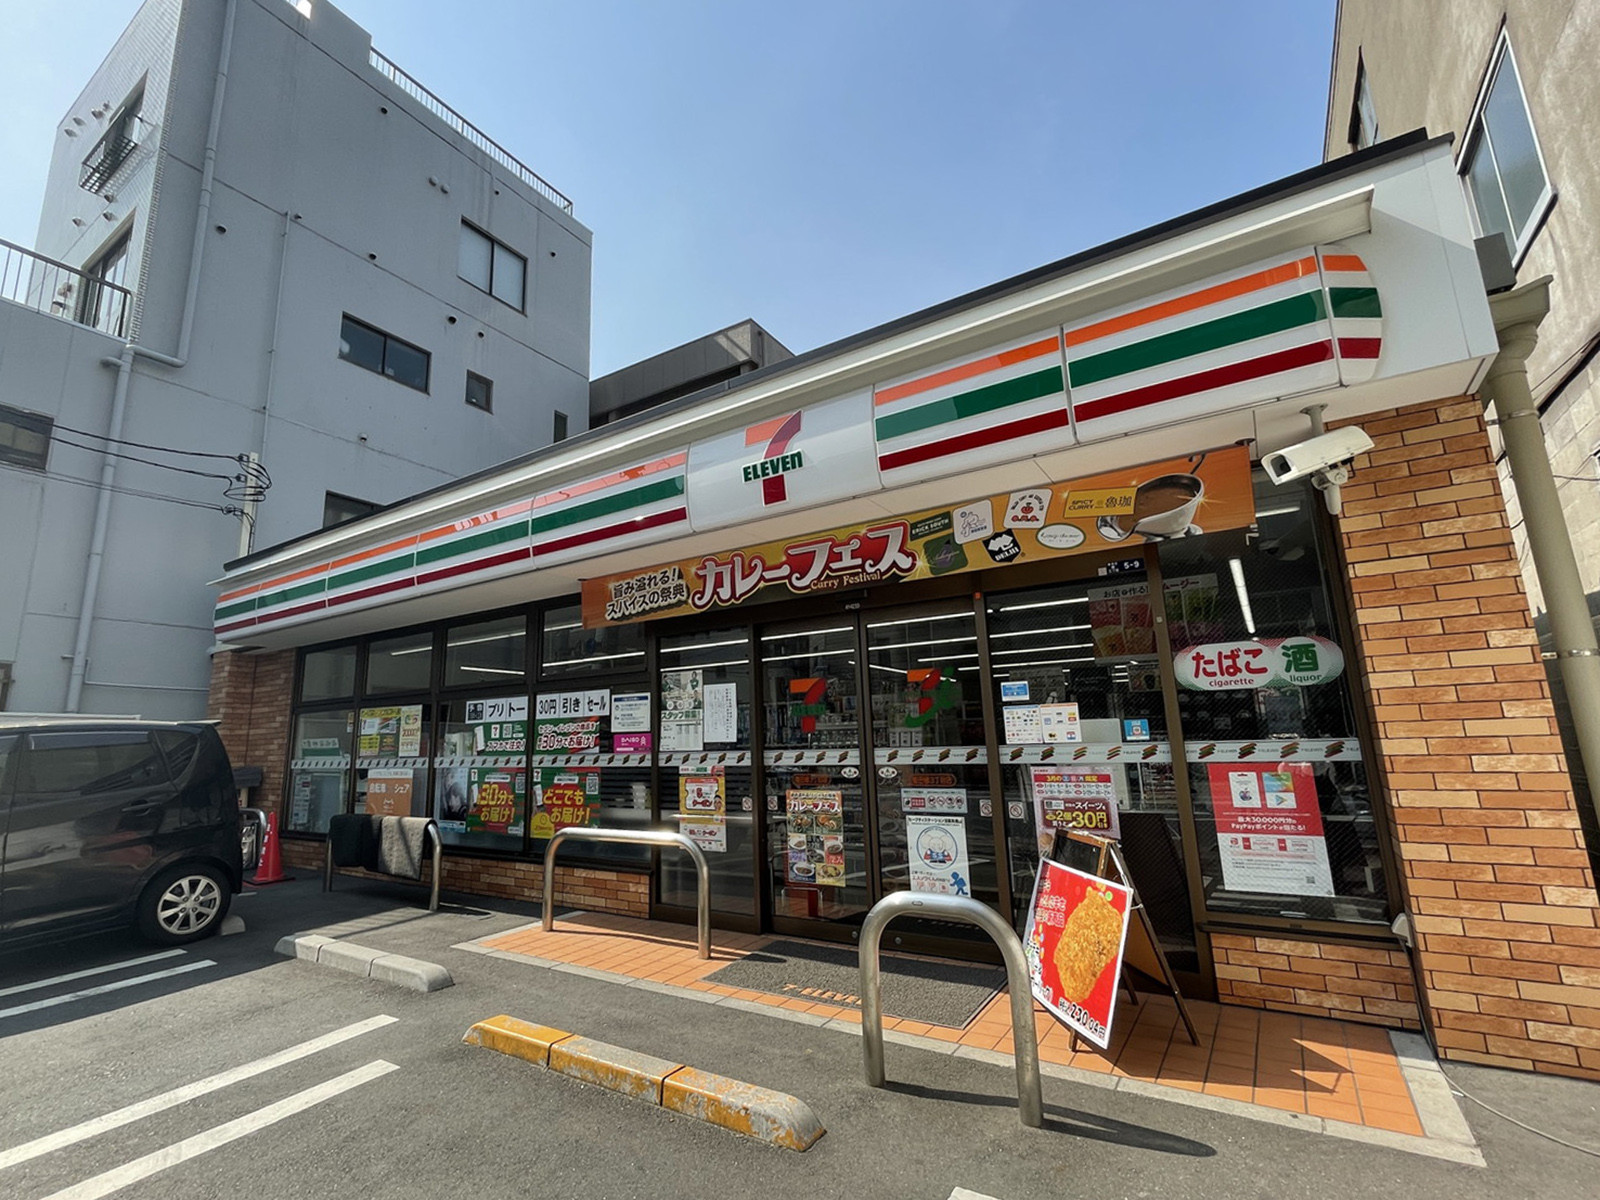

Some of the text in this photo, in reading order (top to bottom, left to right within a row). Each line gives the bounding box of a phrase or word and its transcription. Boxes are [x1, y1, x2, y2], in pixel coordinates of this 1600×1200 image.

[995, 546, 1020, 562] DELHI
[694, 525, 914, 607] カレーフェス
[1123, 560, 1140, 570] 5-9
[842, 570, 881, 587] Festival
[606, 584, 688, 620] スパイスの祭典
[1191, 648, 1268, 678] たばこ
[1281, 643, 1319, 673] 酒
[1209, 678, 1254, 687] cigarette
[1290, 674, 1322, 683] liquor
[543, 789, 584, 805] どこでも
[480, 807, 515, 823] お届け!
[551, 807, 590, 824] お届け!
